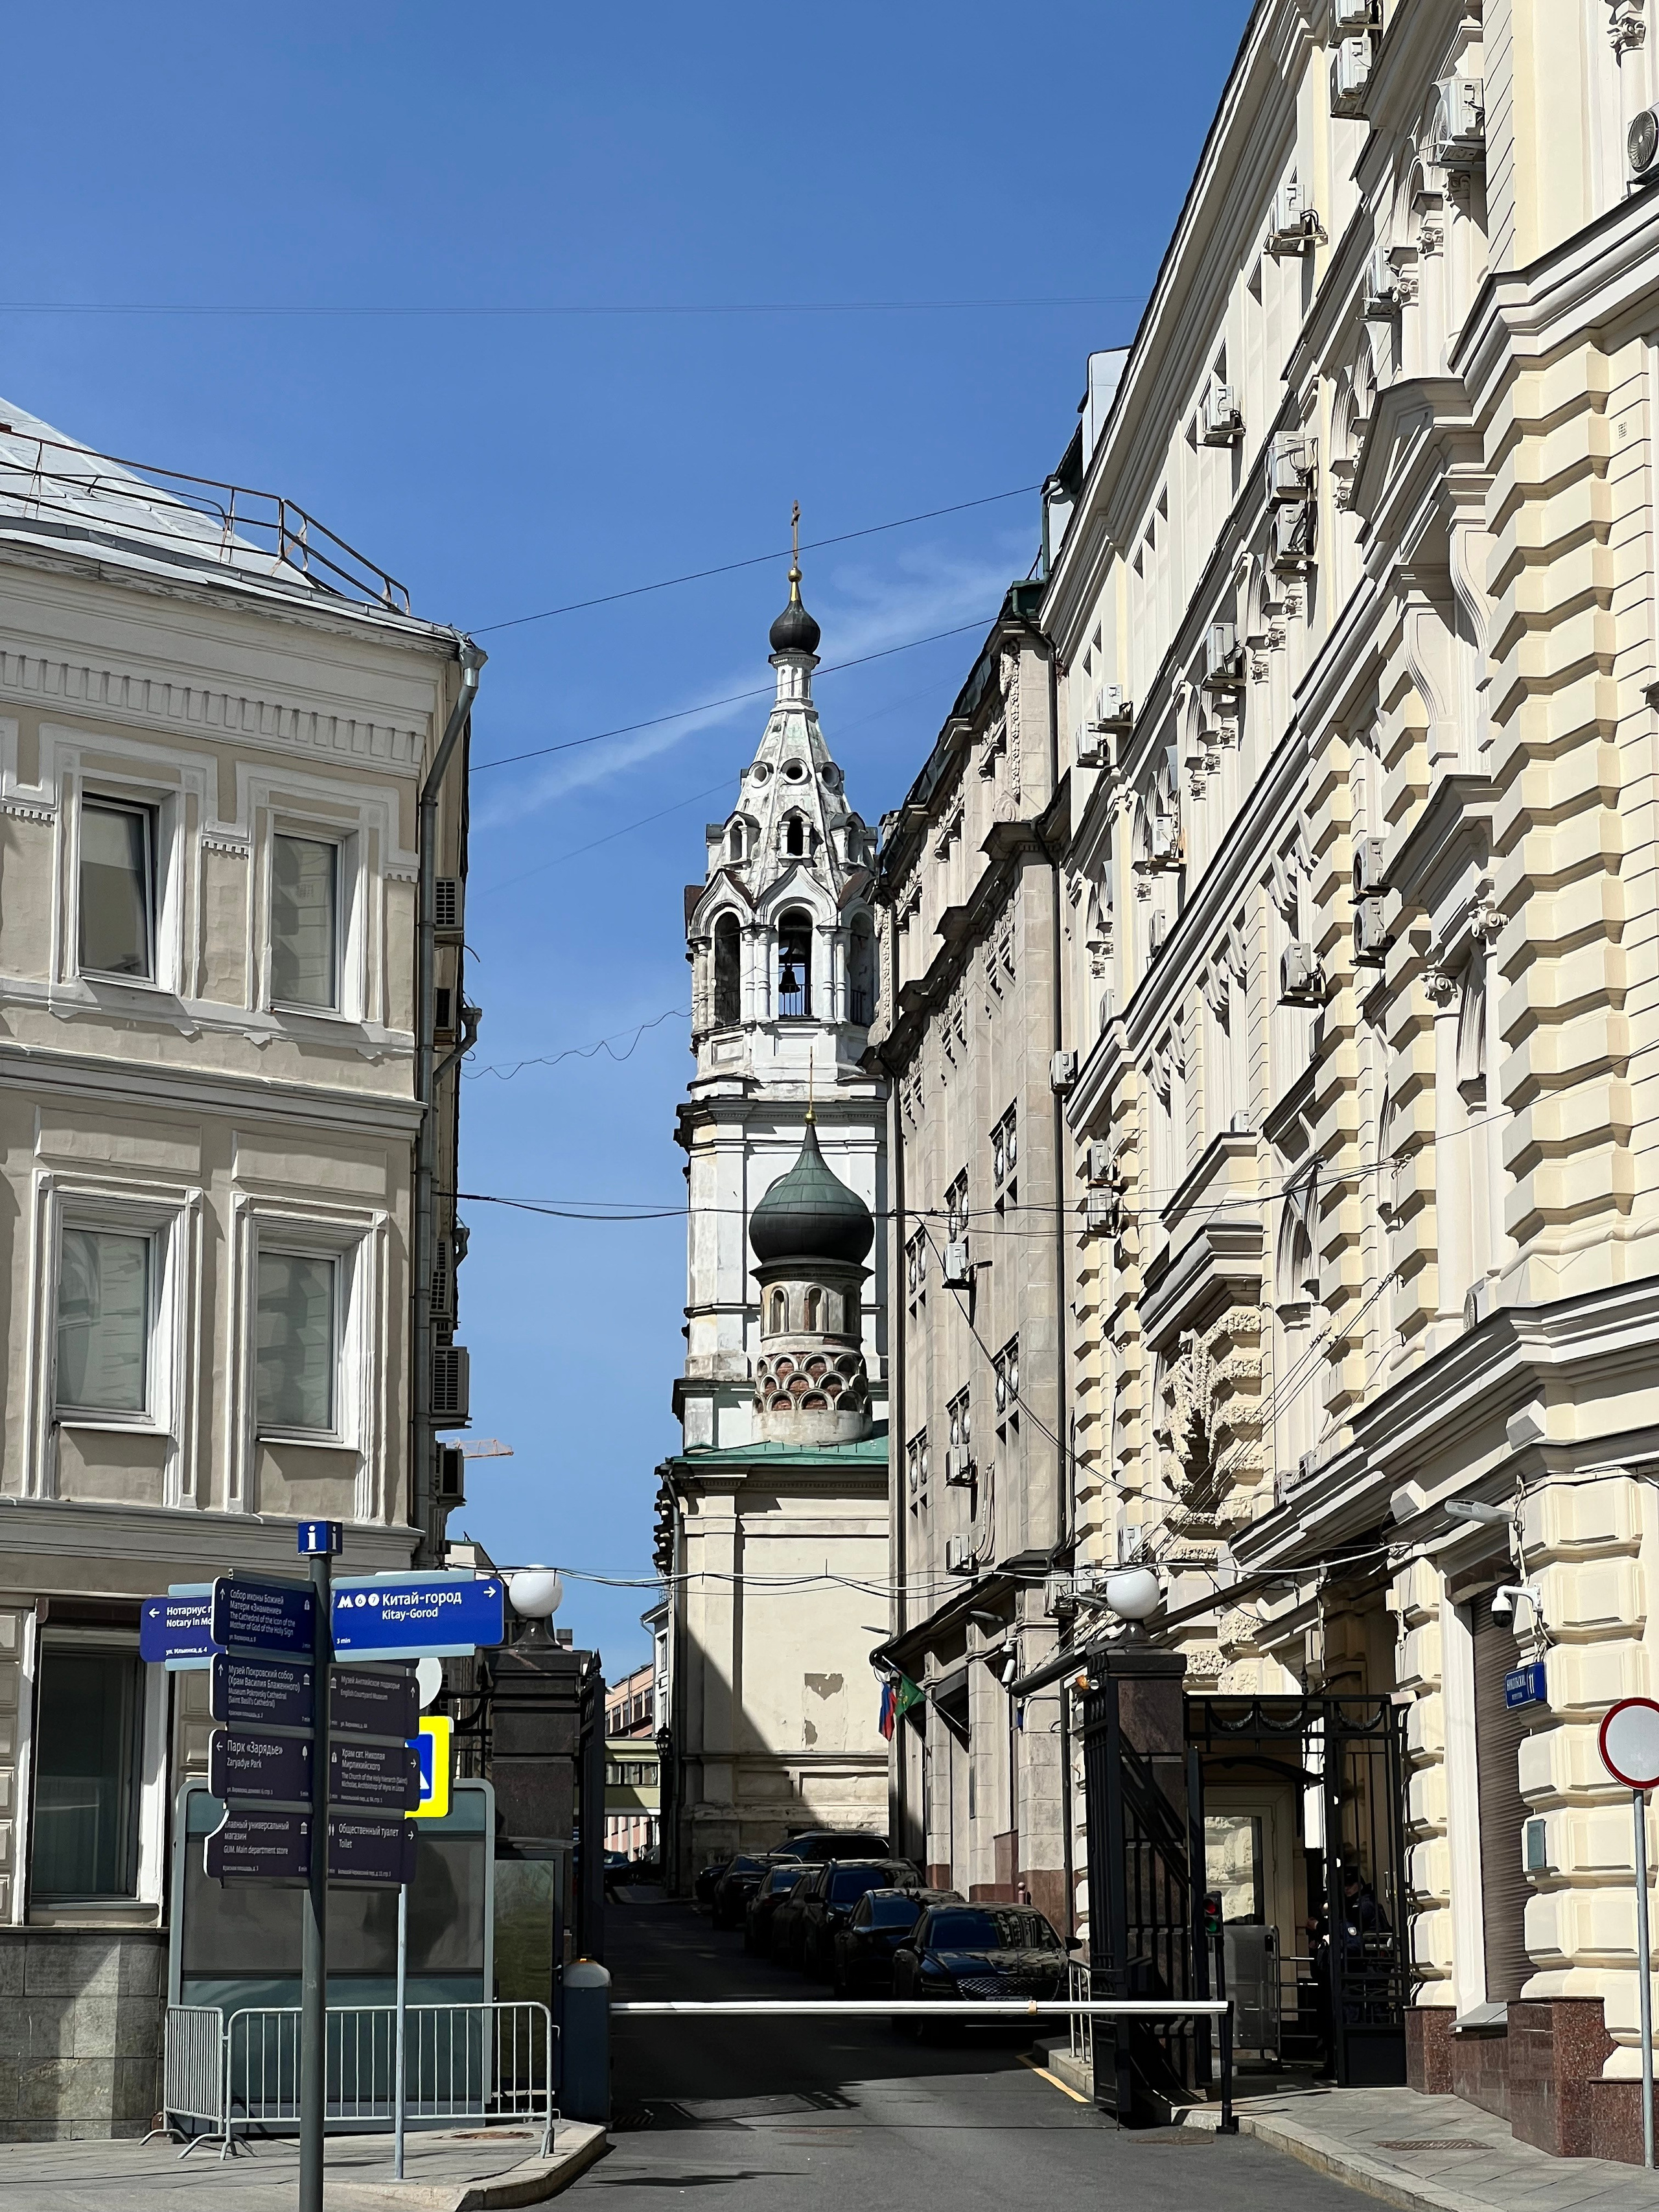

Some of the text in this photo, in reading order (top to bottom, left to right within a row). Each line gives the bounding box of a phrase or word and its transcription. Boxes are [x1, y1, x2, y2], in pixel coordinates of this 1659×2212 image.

[230, 1589, 284, 1605] Собор иконы Божией
[382, 1591, 462, 1607] Китай-город
[167, 1606, 207, 1616] Нотариус
[229, 1600, 250, 1612] Матери
[238, 1612, 260, 1623] Cathedral
[382, 1607, 439, 1622] Kitay-Gorod
[166, 1619, 192, 1628] Notary
[229, 1621, 246, 1630] Mother
[251, 1624, 261, 1632] God
[228, 1665, 294, 1682] Музей Покровский собор
[228, 1675, 244, 1686] (Храм
[244, 1677, 266, 1687] Василия
[341, 1675, 355, 1685] Музей
[1529, 1673, 1535, 1694] 11
[228, 1687, 246, 1695] Museum
[227, 1740, 283, 1757] Парк «Зарядье»
[342, 1748, 355, 1759] Храм
[227, 1757, 262, 1769] Zaryadye Park
[248, 1821, 289, 1832] универсальный
[338, 1823, 399, 1838] Общественный туалет
[339, 1839, 353, 1848] Toilet
[248, 1846, 276, 1856] department
